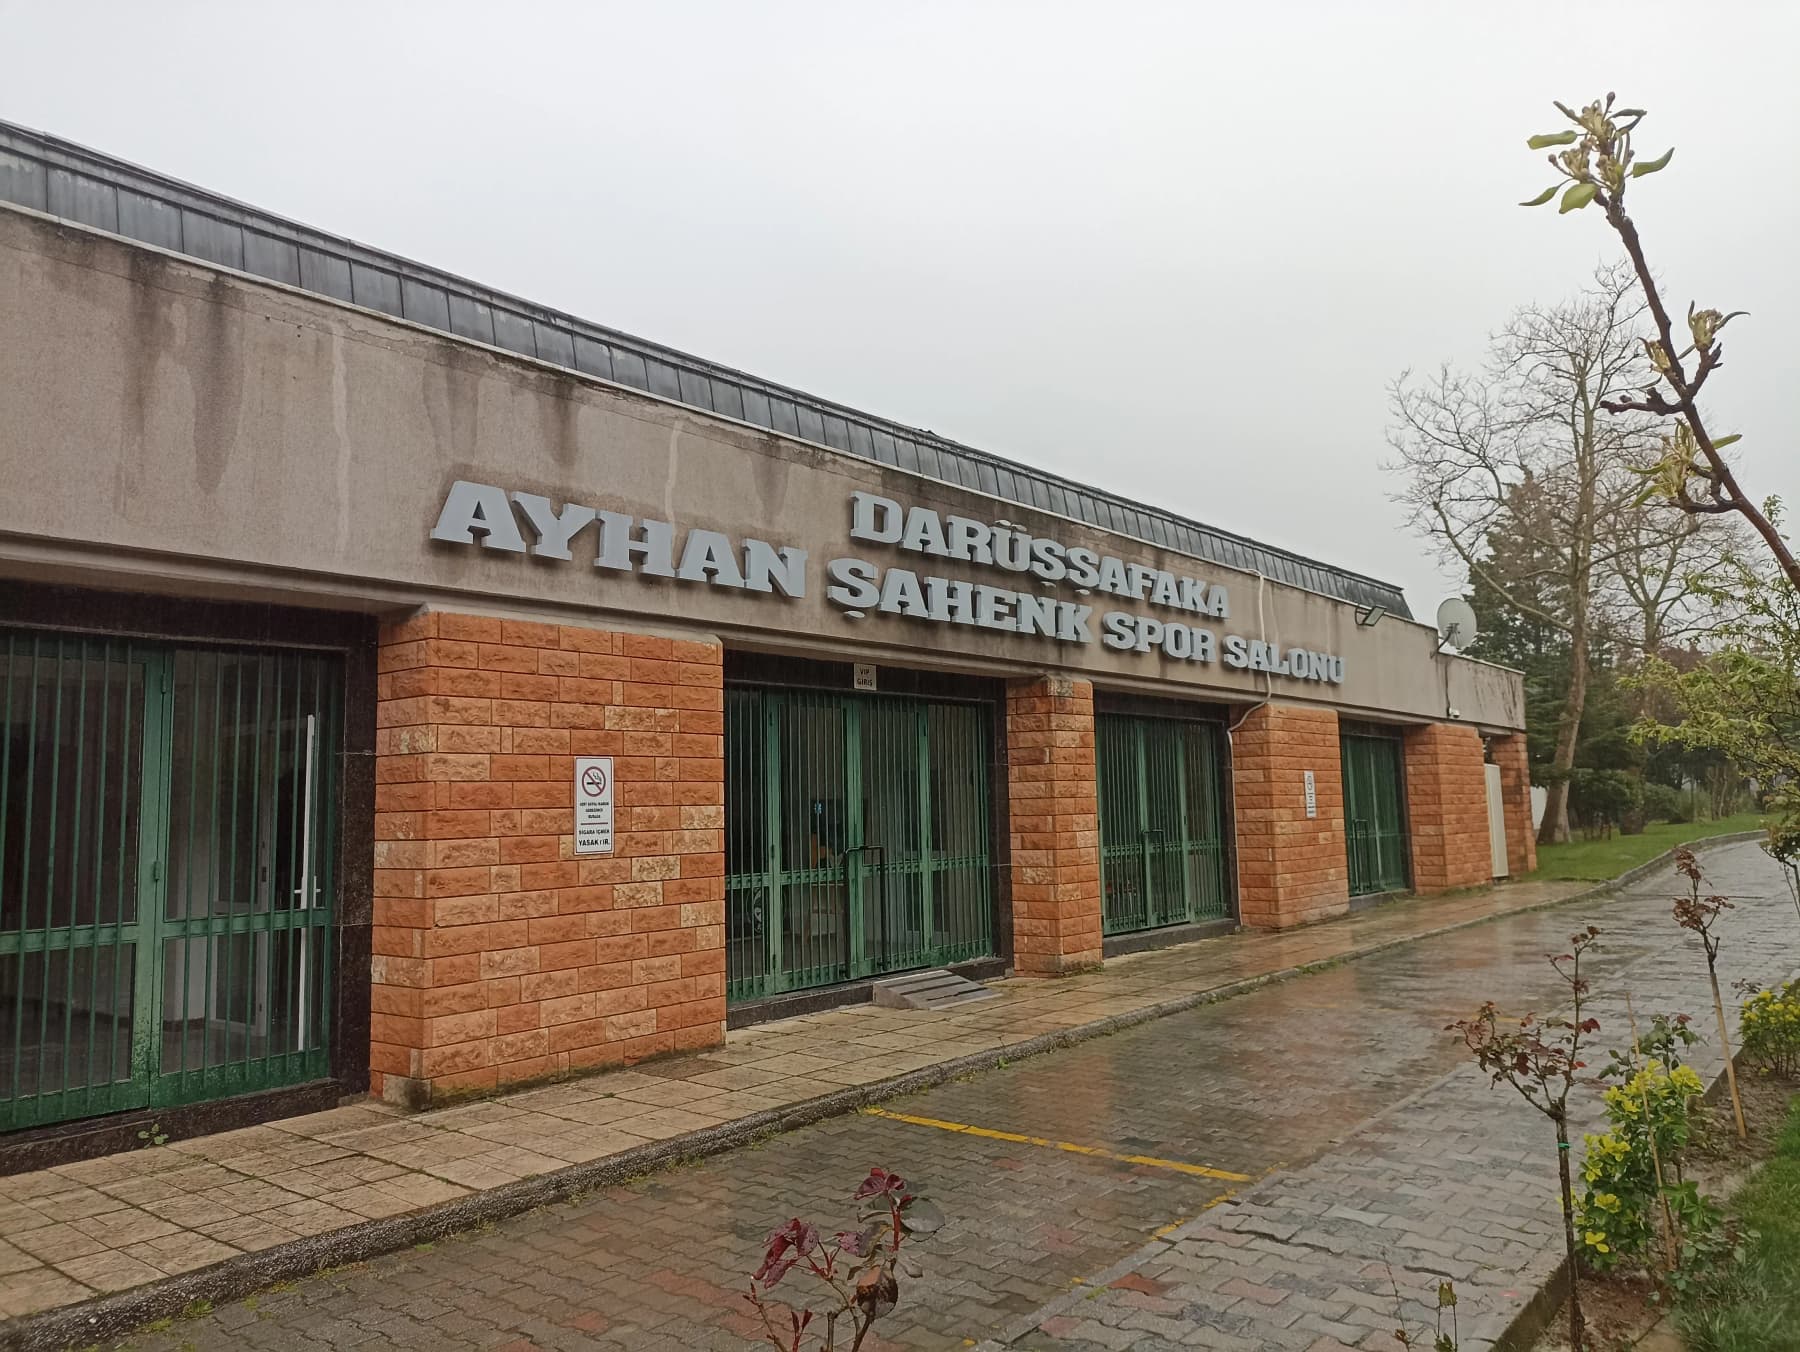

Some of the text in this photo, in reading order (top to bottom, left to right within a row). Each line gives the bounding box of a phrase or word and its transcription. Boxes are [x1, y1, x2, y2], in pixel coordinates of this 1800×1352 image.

[430, 480, 1345, 684] AYHAN ŞAHENK SPOR SALONU
[850, 490, 1230, 618] DARÜŞŞAFAKA
